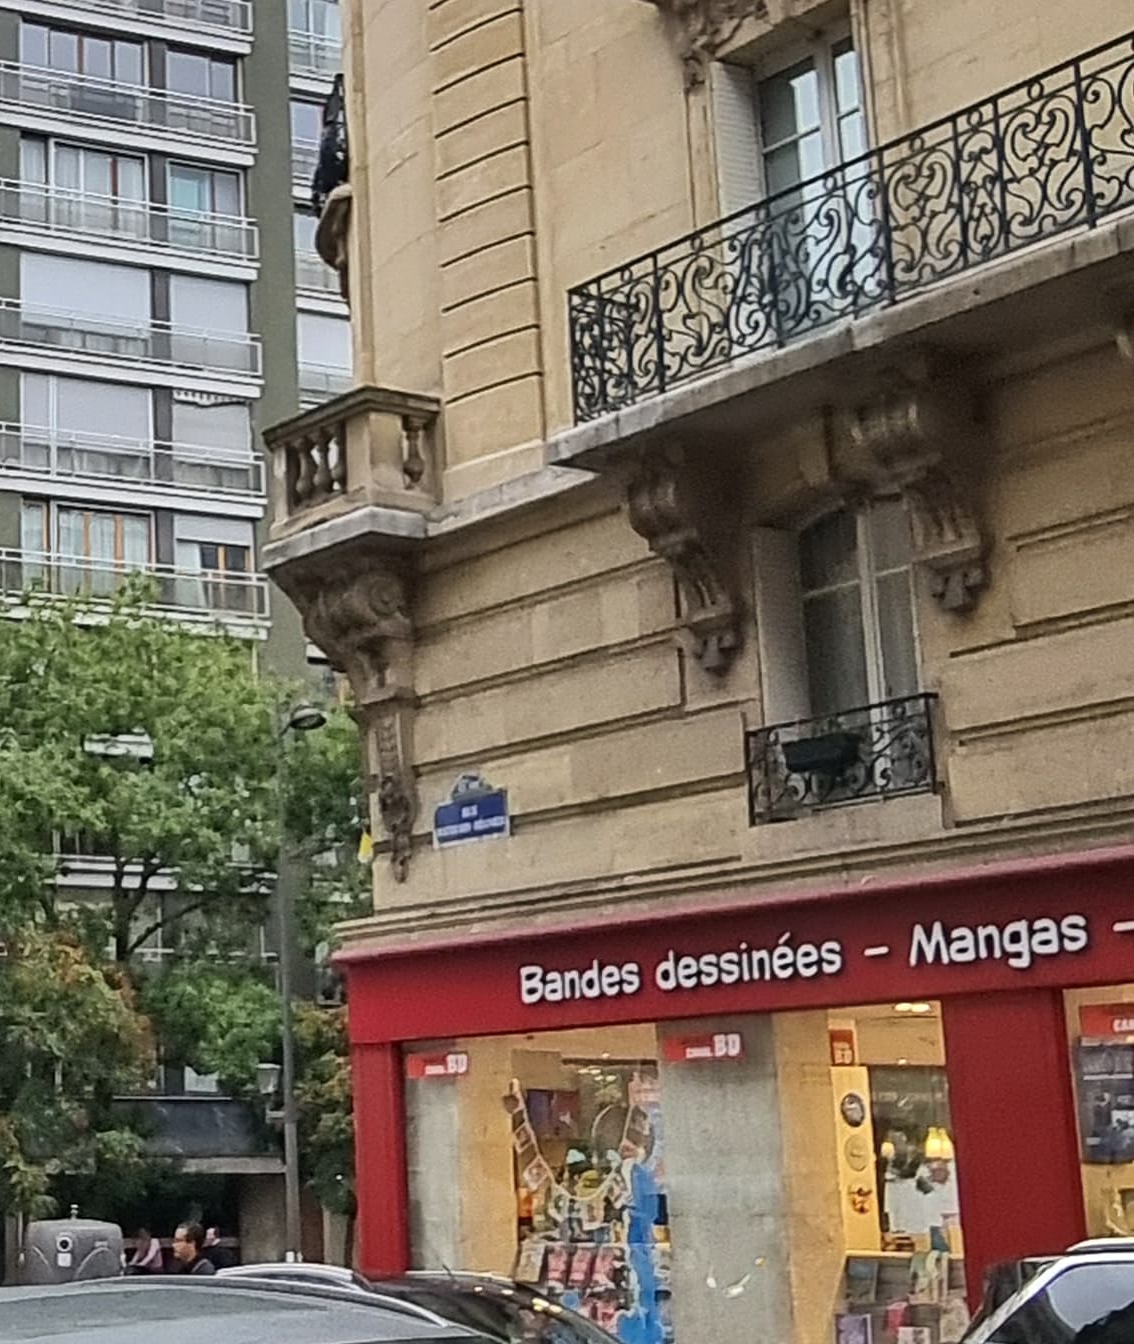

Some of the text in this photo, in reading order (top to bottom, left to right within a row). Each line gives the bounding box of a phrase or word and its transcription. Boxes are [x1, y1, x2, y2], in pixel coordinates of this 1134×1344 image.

[520, 960, 640, 1004] Bandes
[655, 931, 842, 990] dessinées
[909, 914, 1088, 969] Mangas
